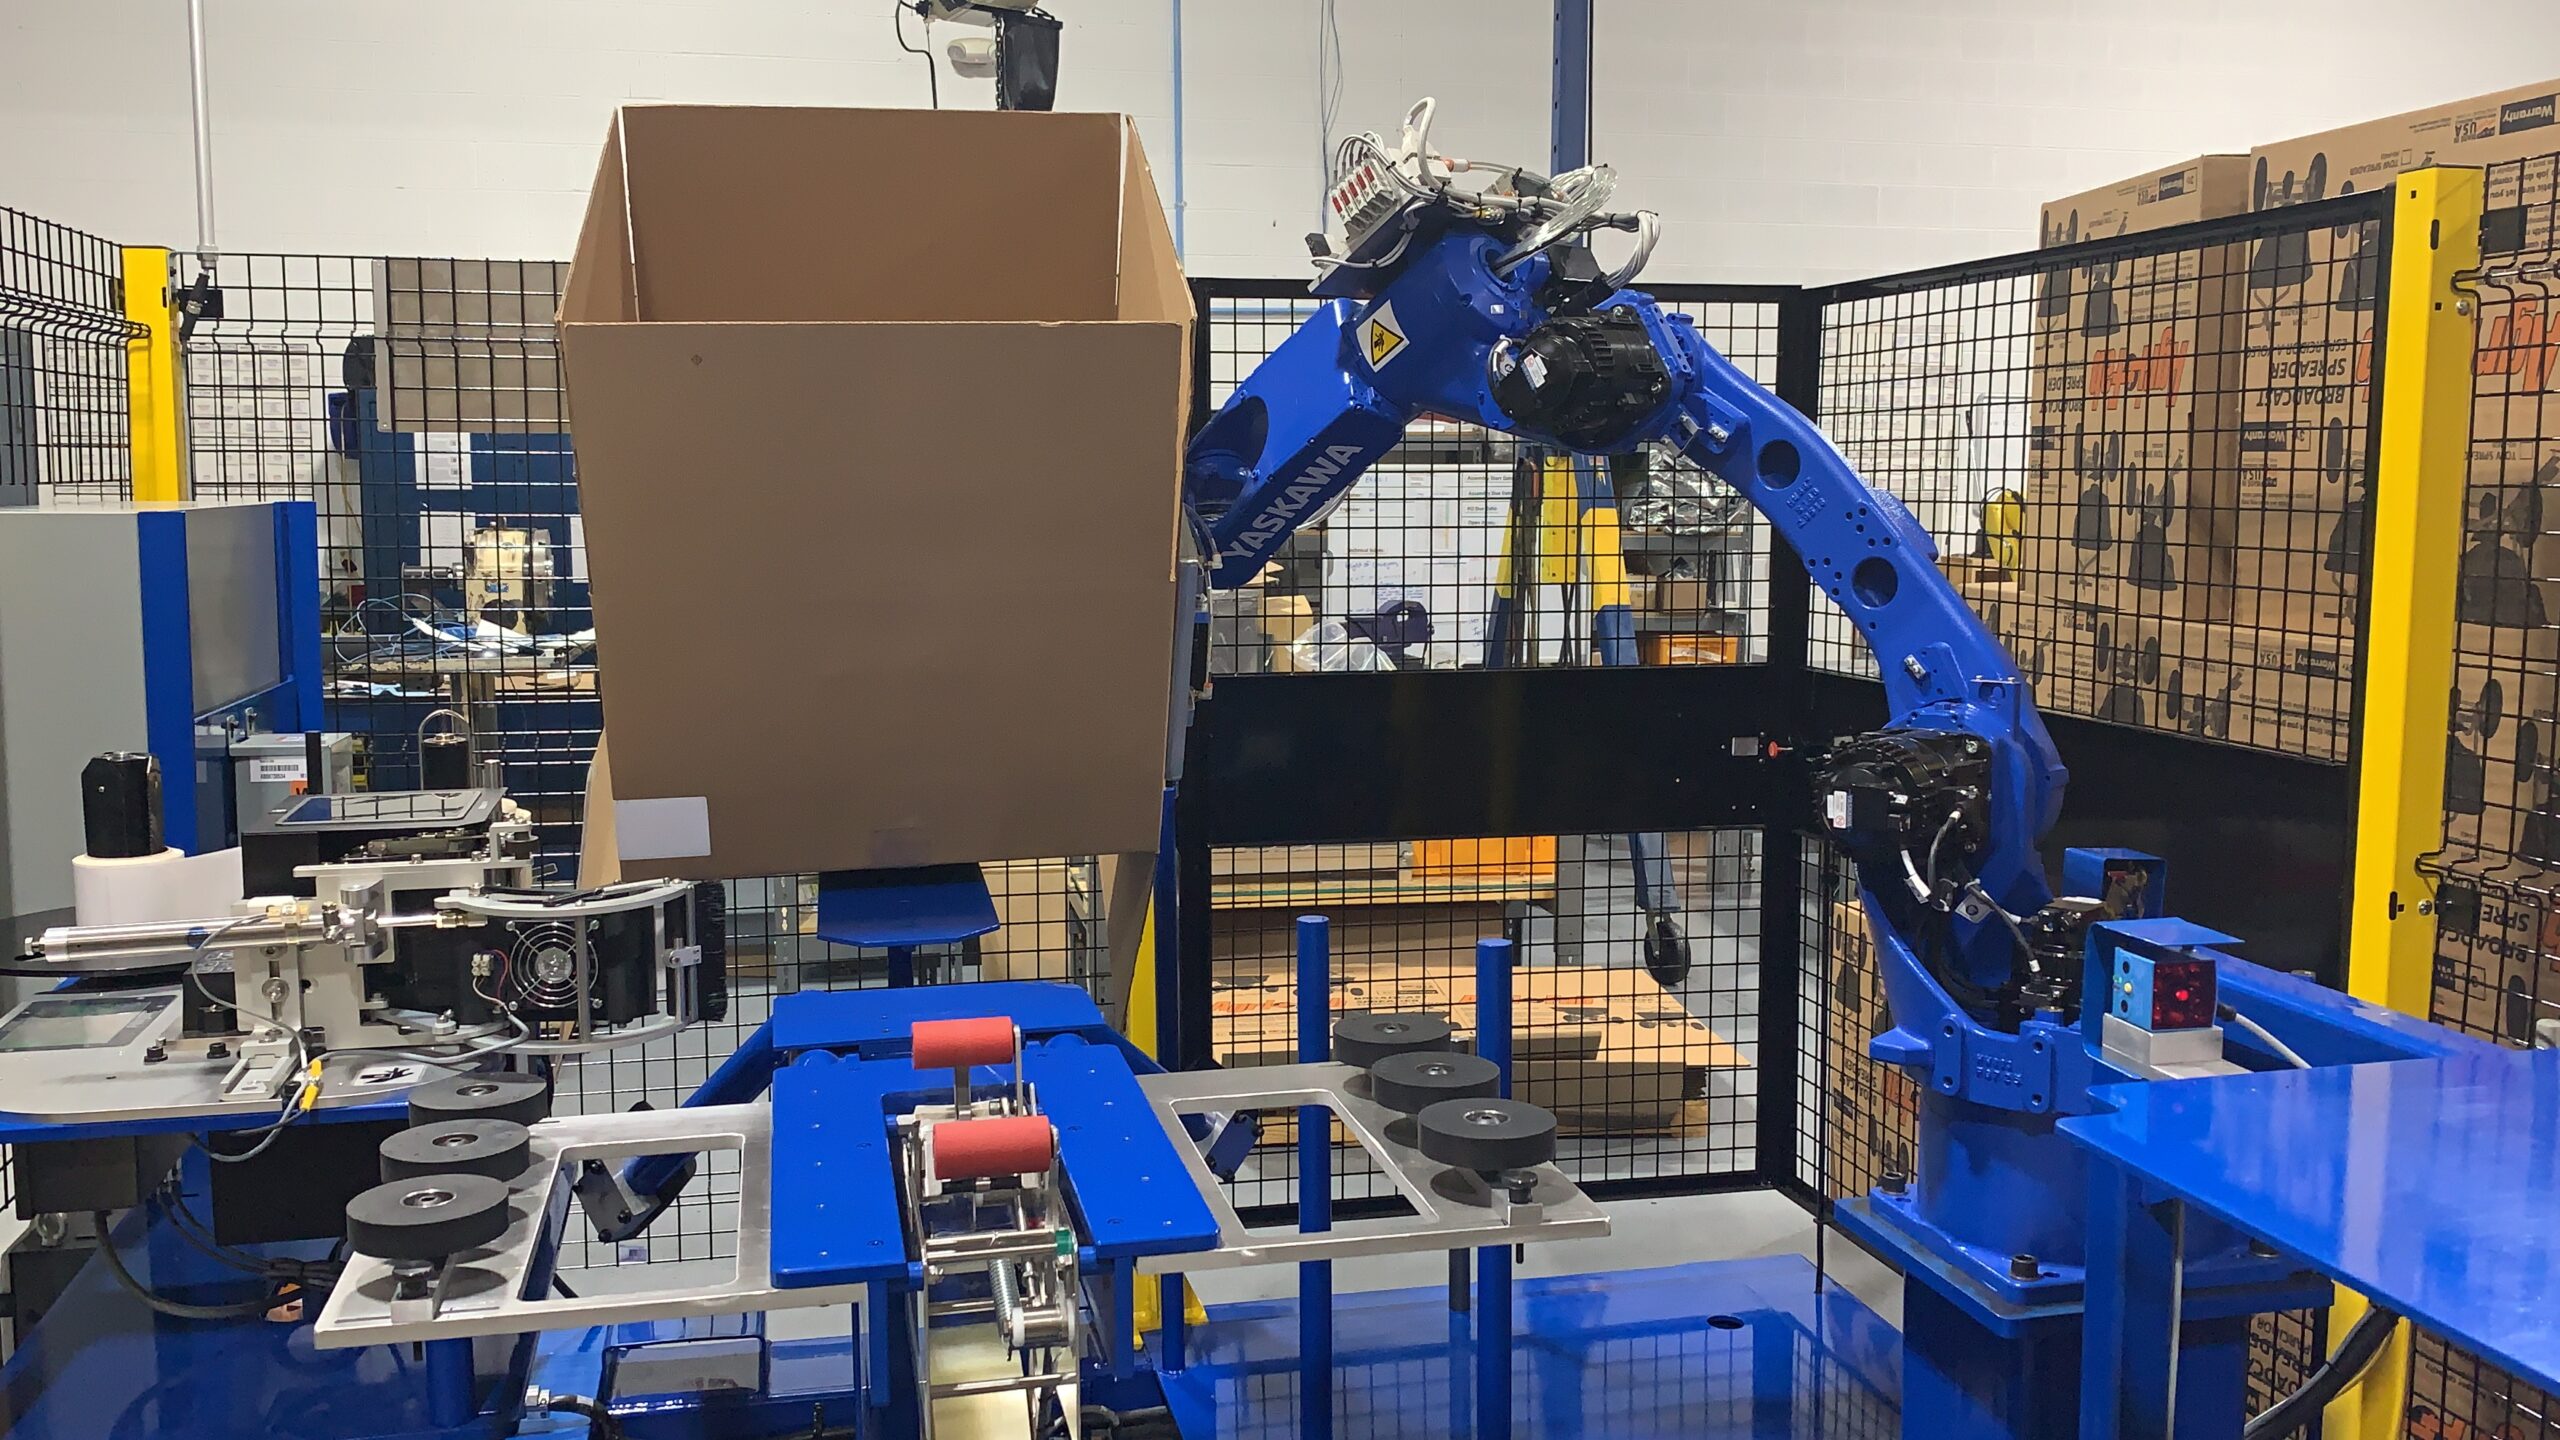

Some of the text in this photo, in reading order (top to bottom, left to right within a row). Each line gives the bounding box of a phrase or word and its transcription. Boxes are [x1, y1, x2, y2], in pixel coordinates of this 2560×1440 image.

[2502, 104, 2553, 123] Warranty
[2454, 121, 2477, 138] USA
[2270, 358, 2347, 380] SPREADER
[2047, 375, 2084, 391] SPREDER
[2244, 430, 2286, 443] Waranty
[1221, 445, 1364, 558] YASKAWA
[2259, 653, 2278, 667] USA
[2296, 654, 2337, 671] Warraty
